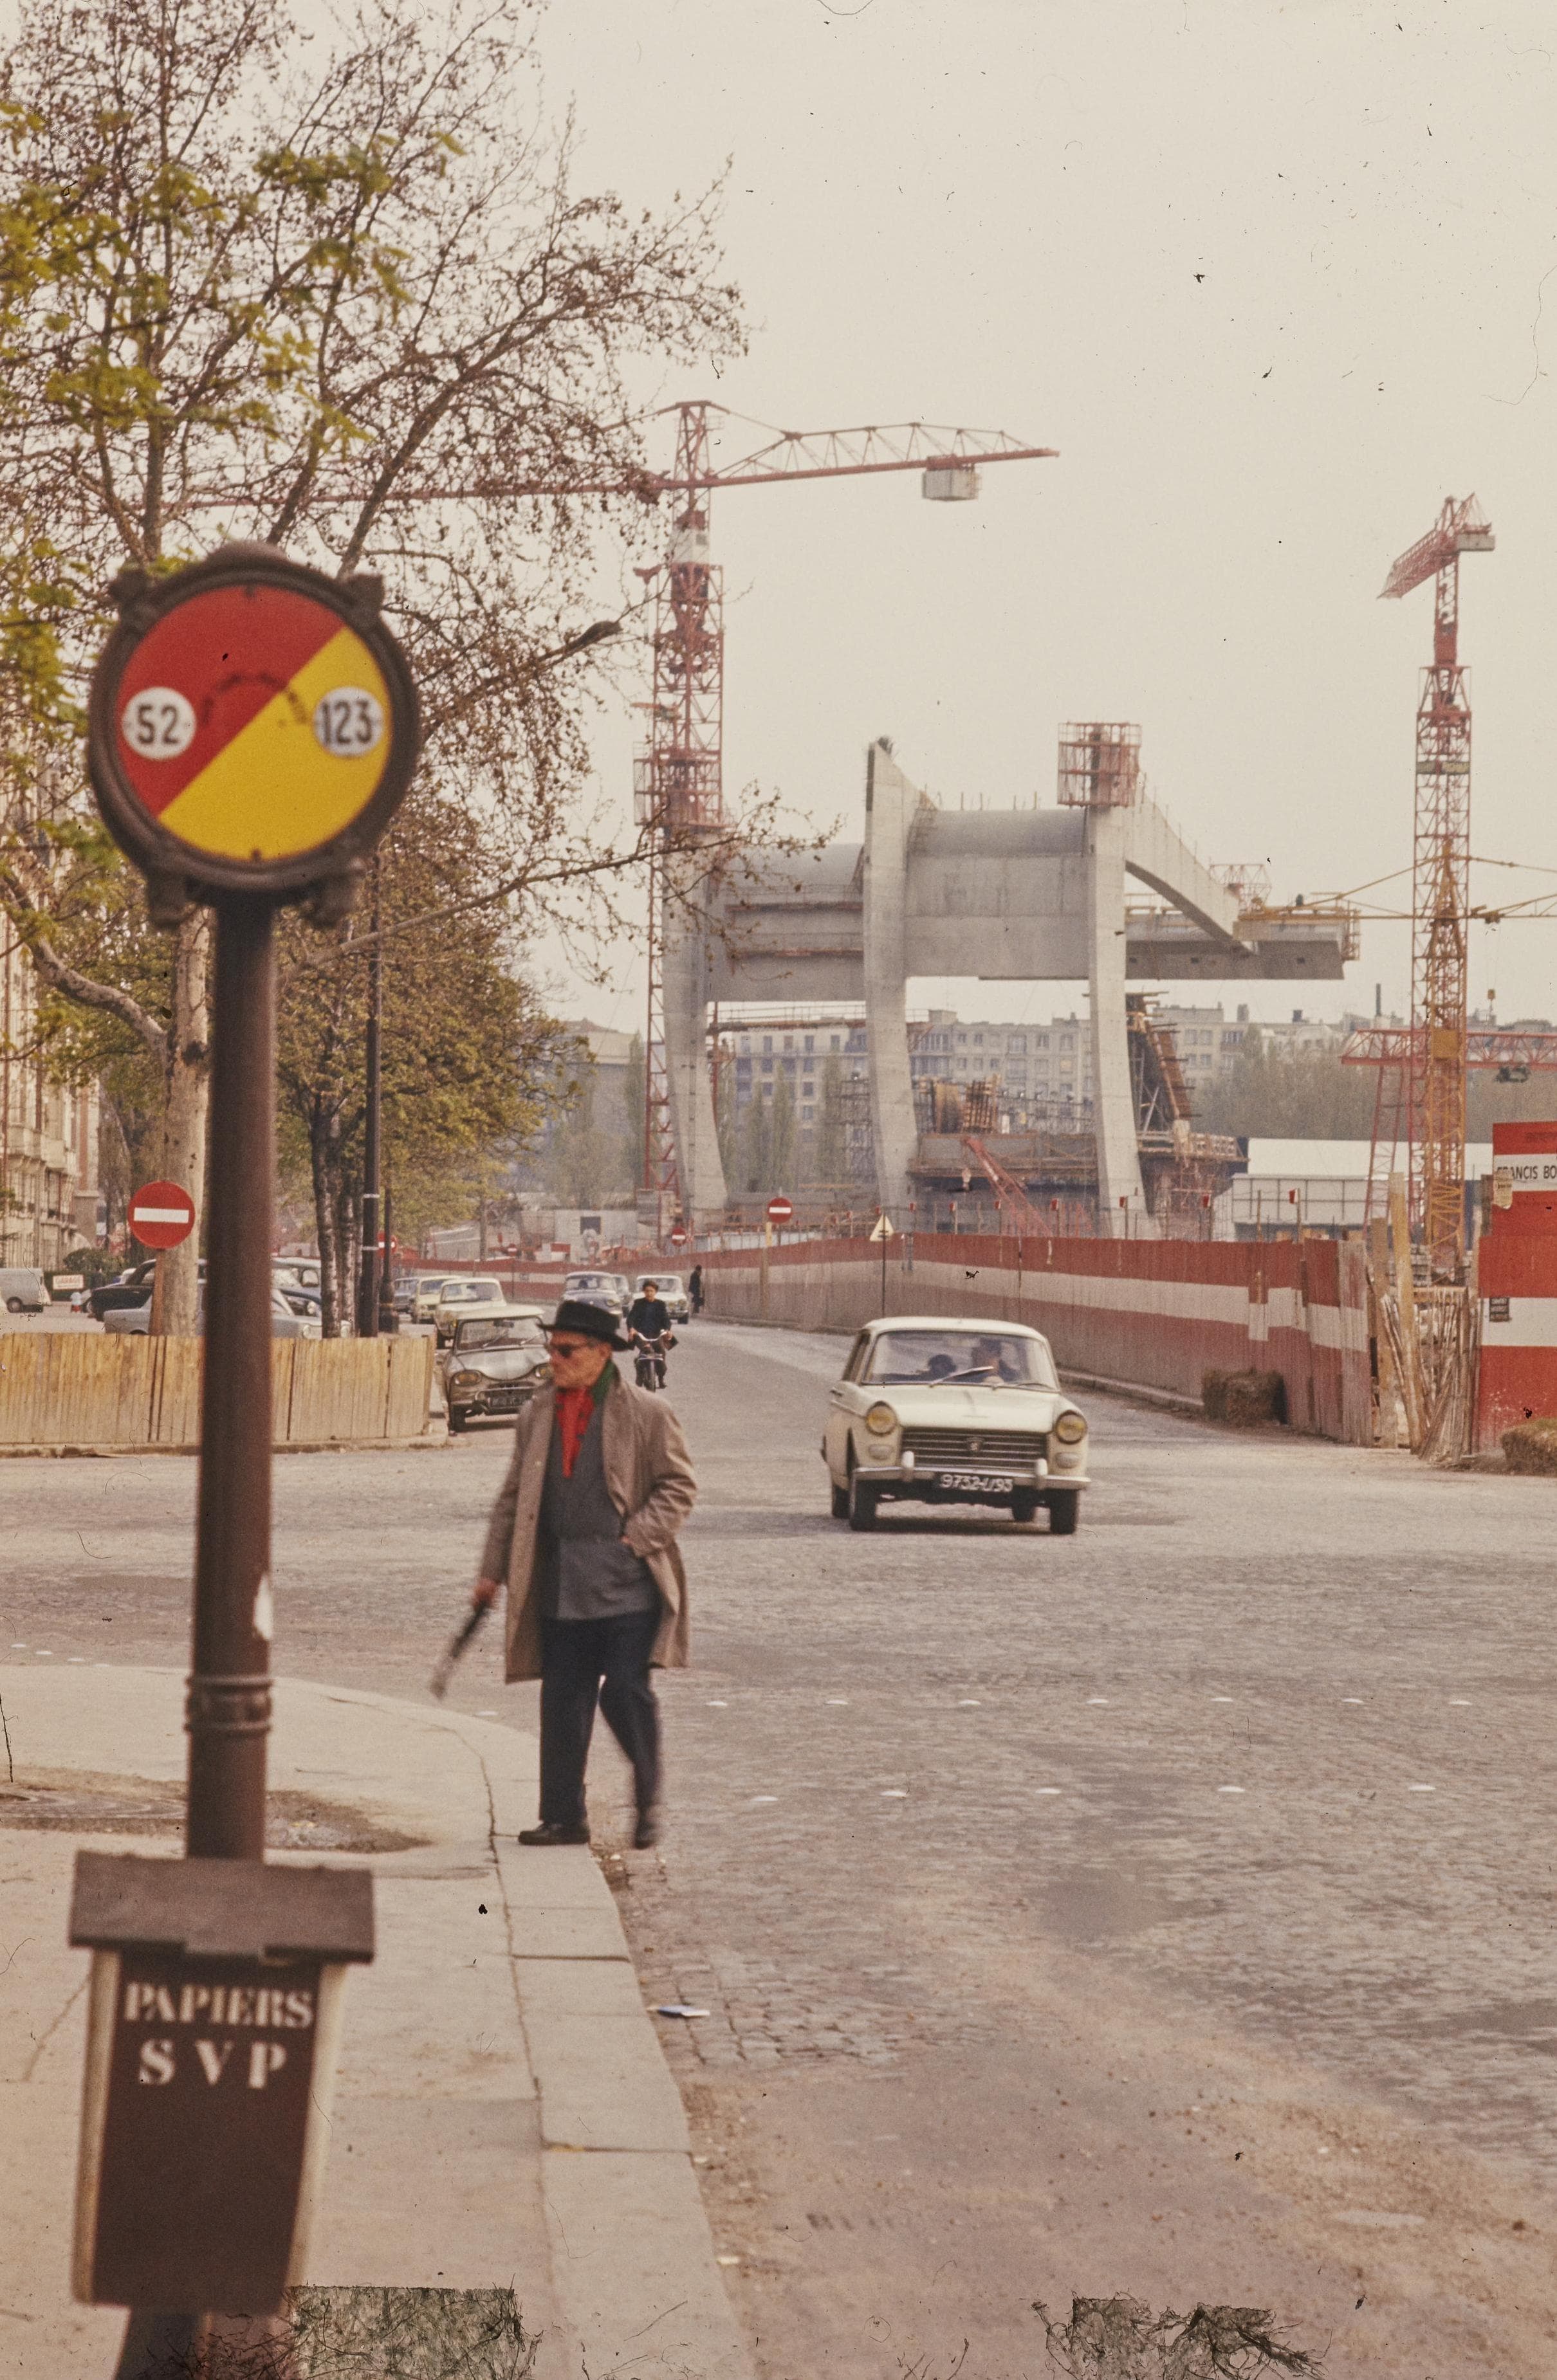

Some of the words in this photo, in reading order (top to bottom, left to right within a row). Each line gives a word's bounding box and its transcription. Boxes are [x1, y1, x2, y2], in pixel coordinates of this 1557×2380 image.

[137, 704, 180, 745] 52
[322, 700, 374, 746] 123
[124, 1981, 314, 2028] PAPIERS
